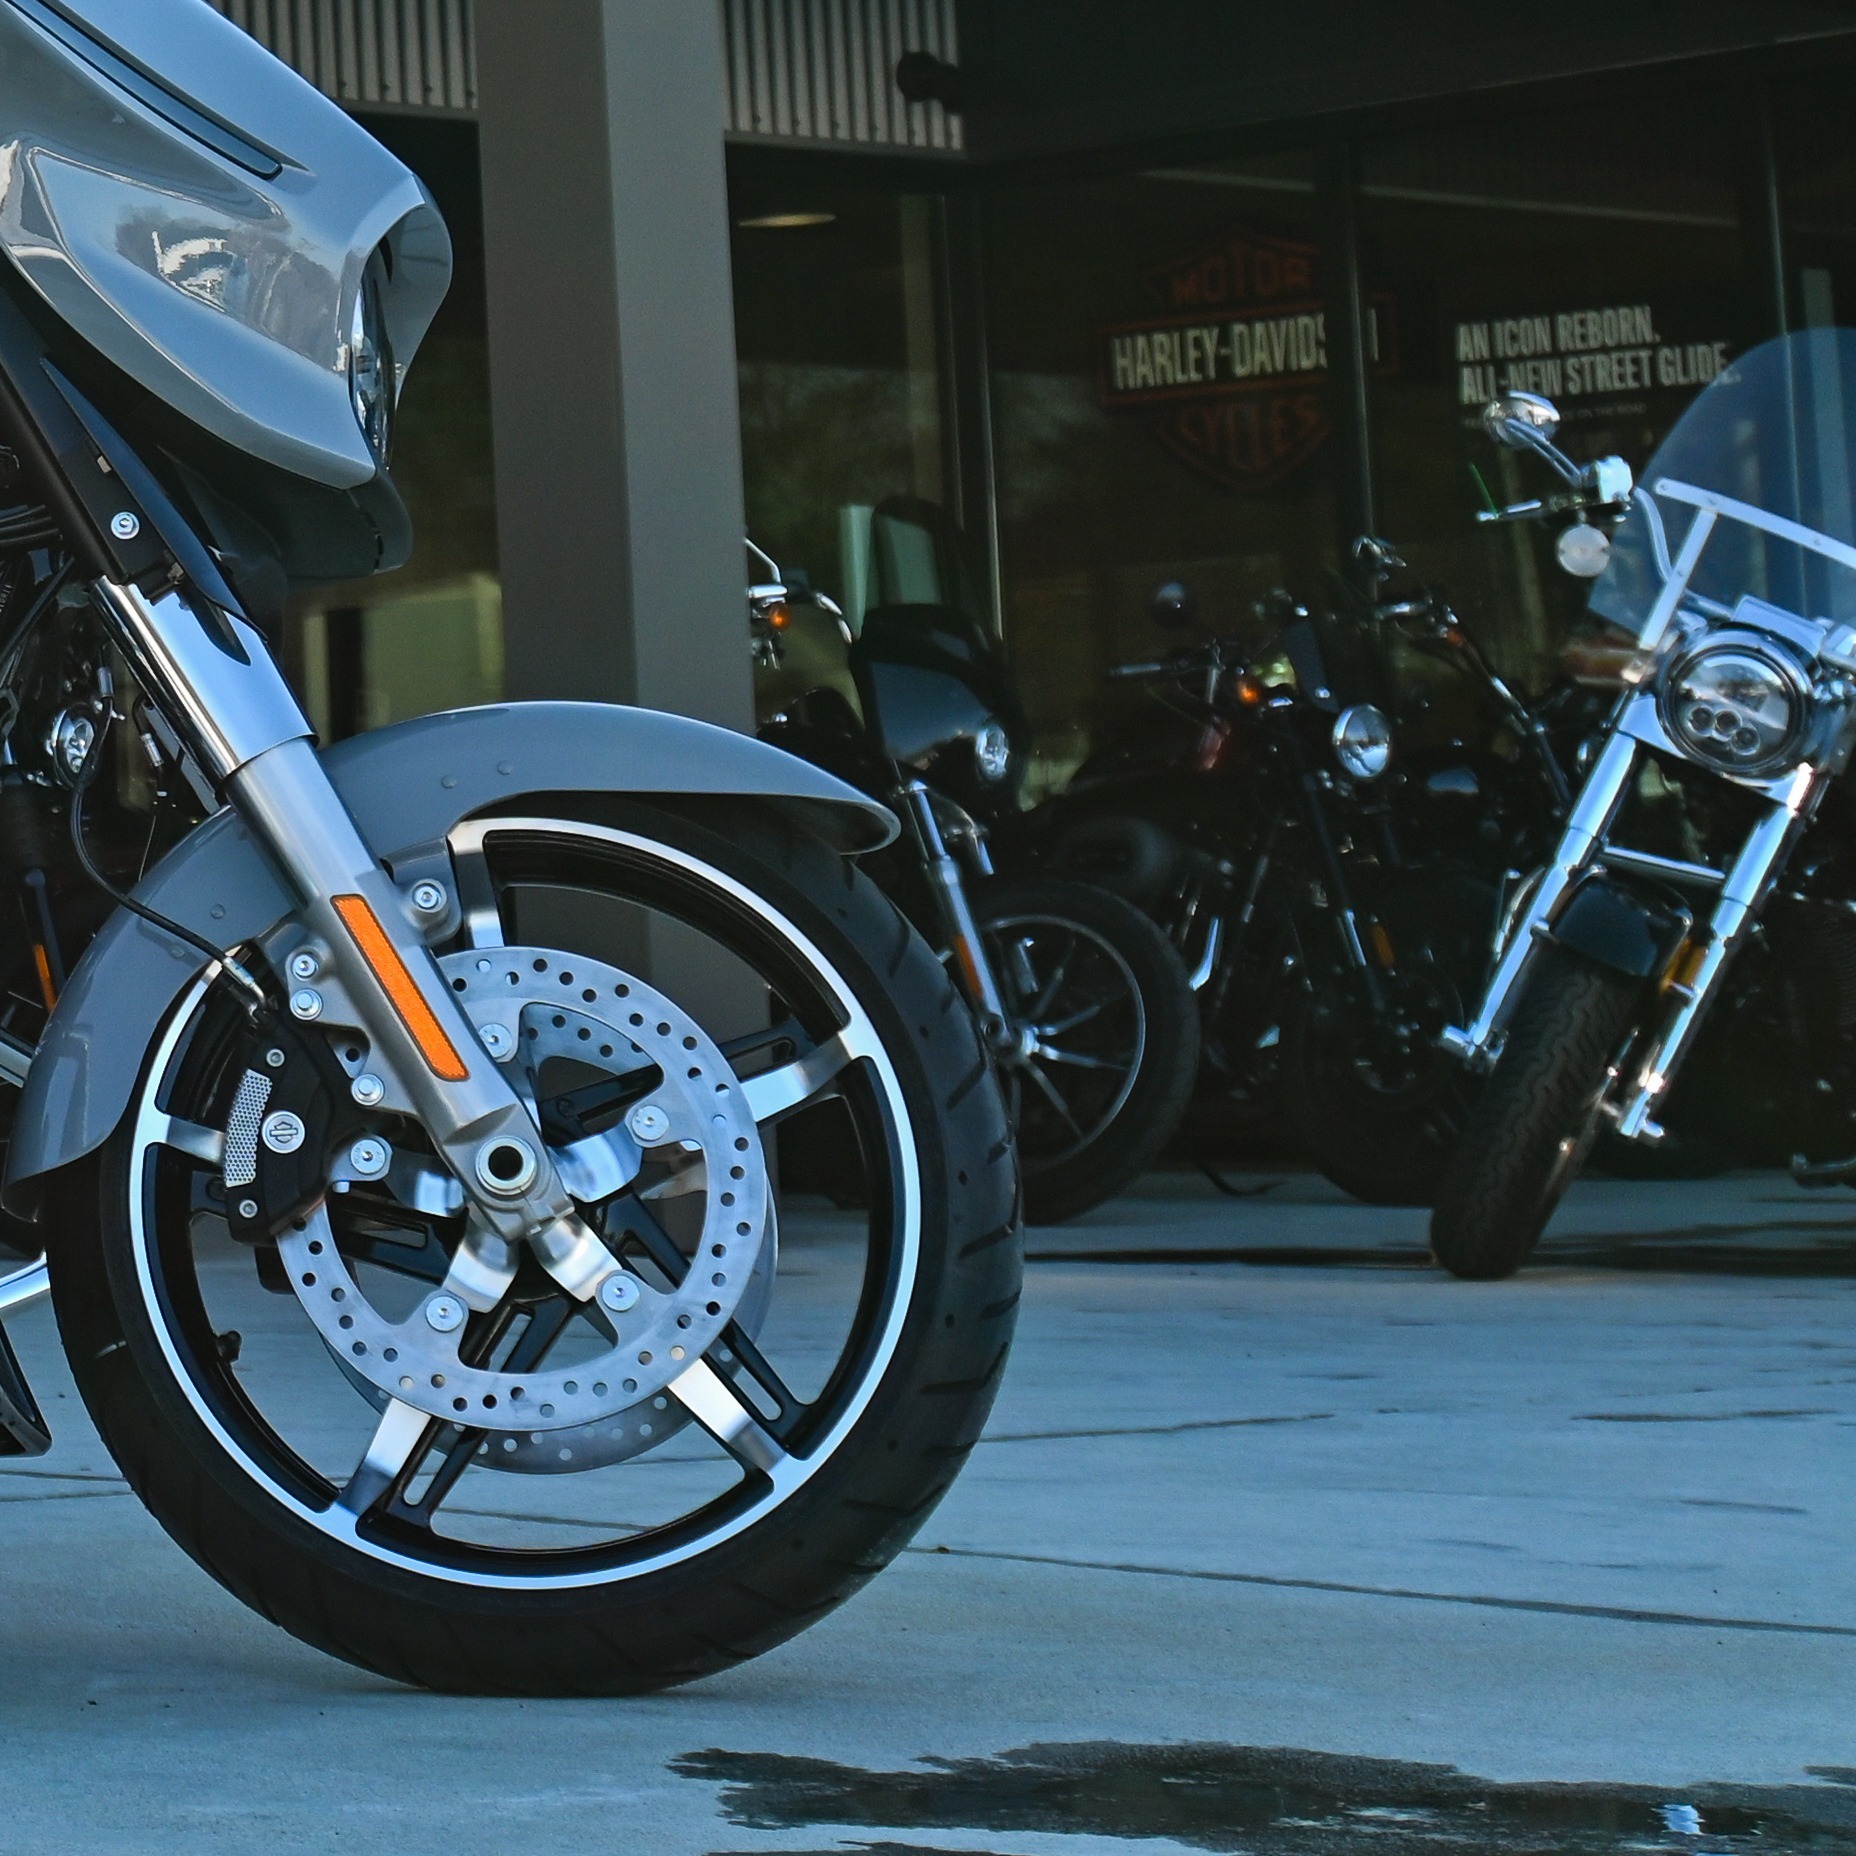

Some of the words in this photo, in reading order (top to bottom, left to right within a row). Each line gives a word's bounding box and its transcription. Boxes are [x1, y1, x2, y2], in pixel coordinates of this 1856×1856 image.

[1111, 306, 1380, 391] HARLEY-DAVID
[1457, 321, 1490, 363] AN
[1491, 315, 1553, 359] ICON
[1554, 304, 1662, 353] REBORN.
[1458, 358, 1564, 405] ALL-NEW
[1565, 347, 1654, 396] STREET
